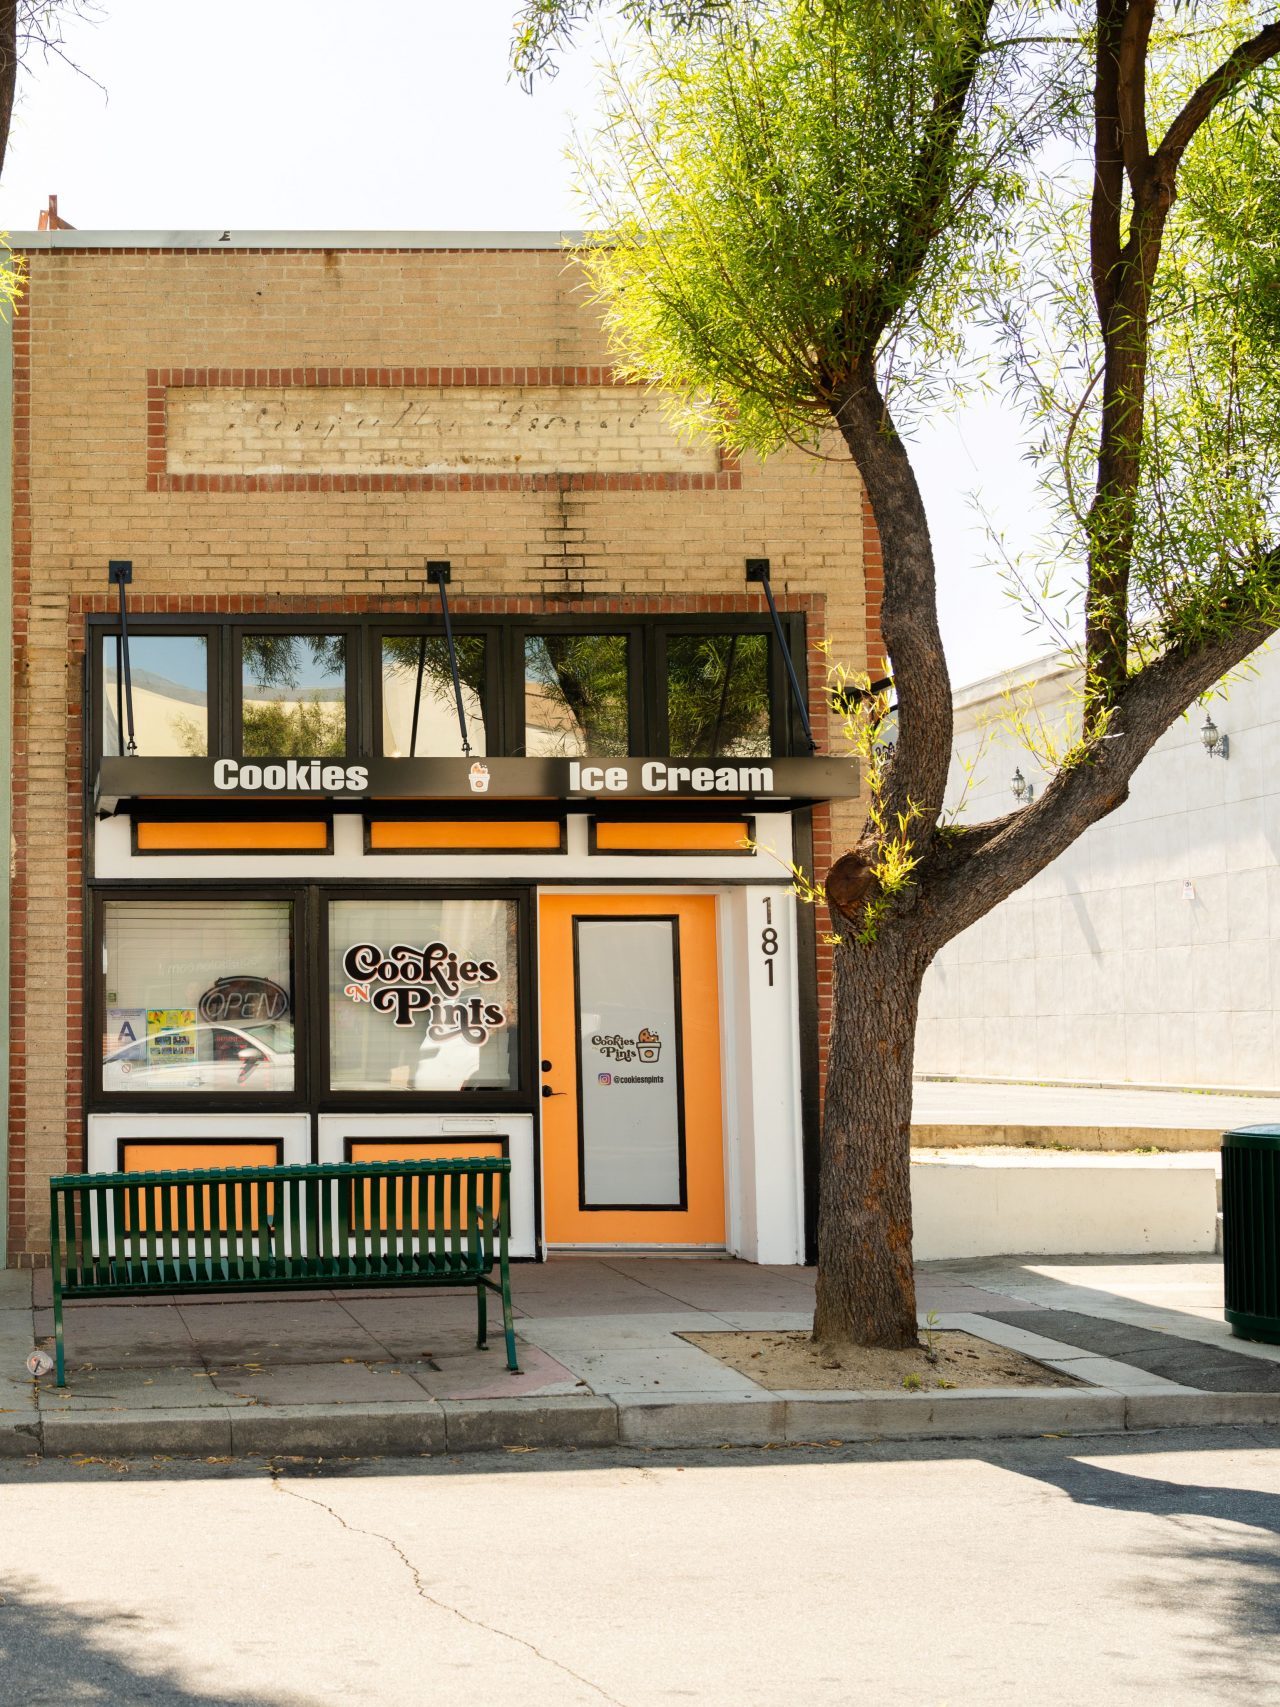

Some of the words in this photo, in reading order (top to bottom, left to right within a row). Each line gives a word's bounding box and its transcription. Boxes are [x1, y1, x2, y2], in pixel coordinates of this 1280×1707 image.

[213, 758, 369, 791] Cookies
[569, 761, 628, 791] Ice
[641, 761, 774, 791] Cream
[761, 896, 779, 987] 181
[343, 941, 500, 999] Cookies
[206, 992, 280, 1017] OPEN
[371, 985, 507, 1047] Pints
[118, 1021, 137, 1041] A
[591, 1034, 635, 1049] Cookies
[600, 1046, 637, 1062] Pints
[613, 1075, 664, 1085] @cookiesnpints
